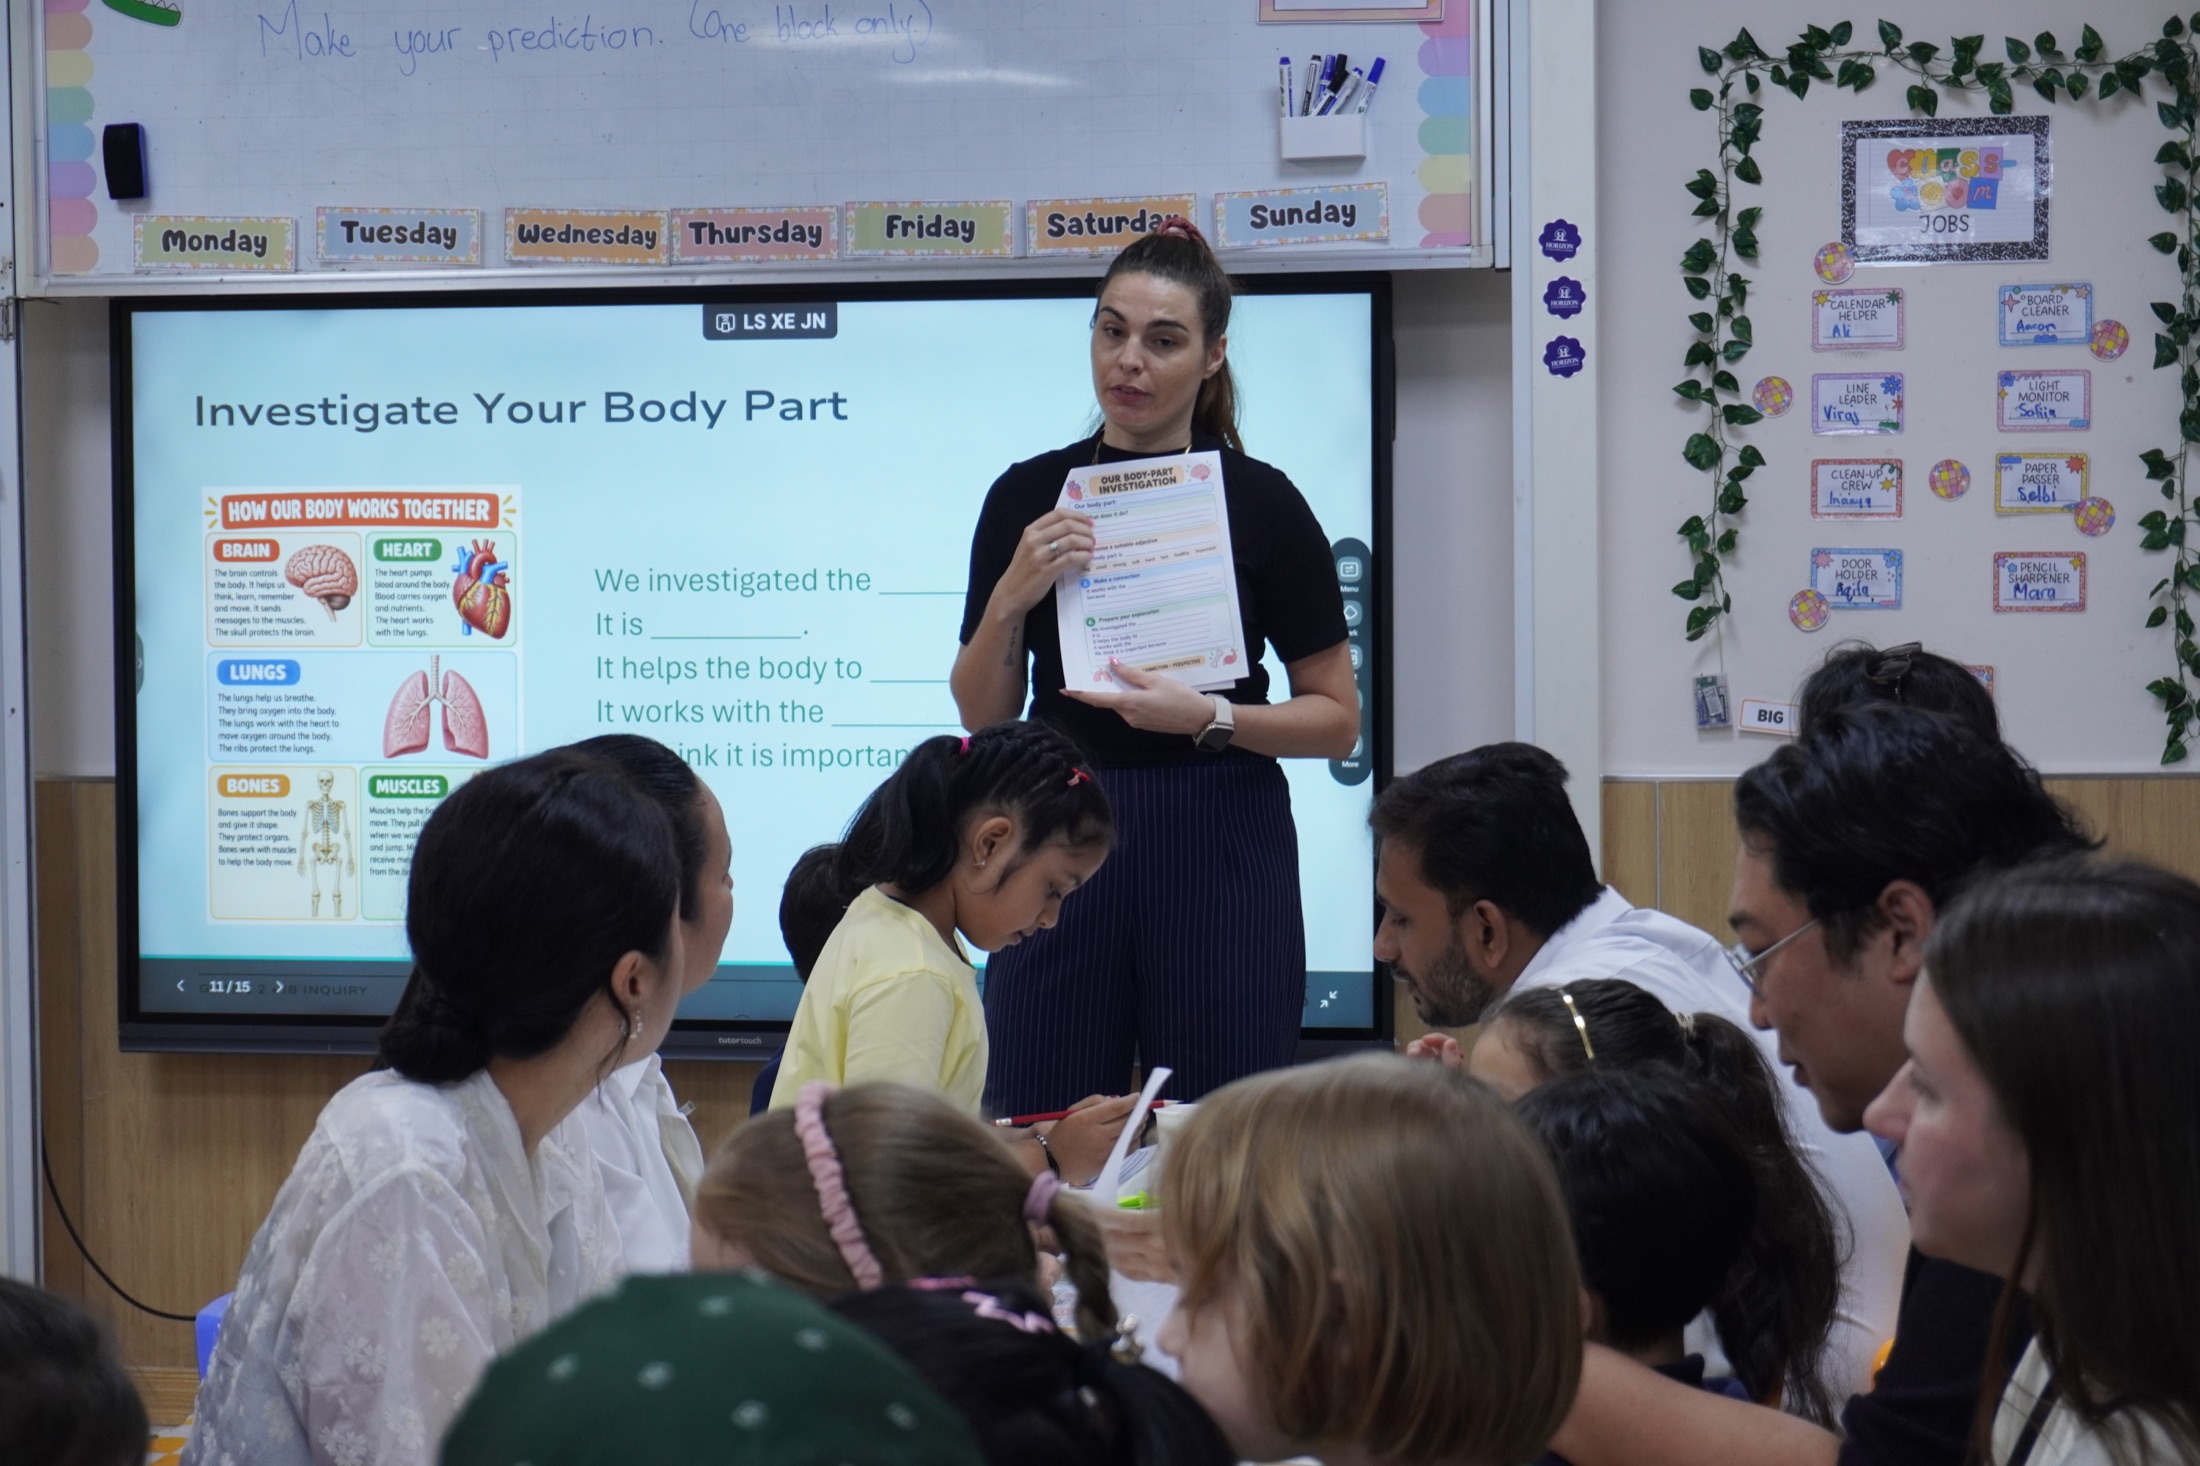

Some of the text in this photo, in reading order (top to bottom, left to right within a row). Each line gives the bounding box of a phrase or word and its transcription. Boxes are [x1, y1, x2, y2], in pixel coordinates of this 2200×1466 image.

[258, 0, 356, 60] Make
[394, 27, 461, 76] your
[487, 13, 664, 61] prediction.
[776, 3, 837, 43] block
[1249, 200, 1357, 230] Sunday
[885, 214, 976, 244] Friday
[1046, 209, 1179, 238] Saturda
[1919, 214, 1969, 233] JOBS
[340, 219, 459, 250] Tuesday
[516, 223, 659, 251] Wednesday
[688, 219, 824, 248] Thursday
[161, 227, 269, 258] Monday
[1830, 299, 1886, 310] CALENDAR
[2027, 294, 2063, 306] BOARD
[1839, 310, 1878, 321] HELPER
[2022, 305, 2069, 317] CLEANER
[744, 313, 826, 329] LS XE JN
[1551, 358, 1579, 367] HORIZON
[1846, 383, 1869, 394] LINE
[2029, 380, 2059, 391] LIGHT
[1839, 394, 1877, 405] LEADER
[2018, 392, 2069, 402] MONITOR
[195, 390, 848, 433] Investigate Your Body Part
[1831, 469, 1883, 479] CLEAN-UP
[2025, 463, 2057, 473] PAPER
[1102, 468, 1173, 484] OUR BODY-PART
[2022, 474, 2059, 485] PASSER
[1099, 476, 1176, 495] INVESTIGATION
[1842, 481, 1872, 491] CREW
[228, 498, 490, 522] HOW OUR BODY WORKS TOGETHER
[1103, 500, 1116, 508] part:
[222, 543, 270, 558] BRAIN
[383, 542, 432, 557] HEART
[1842, 559, 1872, 569] DOOR
[2021, 562, 2058, 572] PENCIL
[214, 569, 278, 577] The brain controls
[375, 569, 432, 578] The heart pumps
[1835, 570, 1878, 580] HOLDER
[2008, 572, 2070, 583] SHARPENER
[433, 581, 451, 590] body.
[595, 568, 871, 597] We investigated the
[422, 594, 447, 602] oxygen
[596, 612, 643, 636] It is
[407, 629, 428, 638] lungs.
[230, 664, 286, 680] LUNGS
[597, 655, 862, 684] It helps the body to
[218, 693, 231, 702] The
[233, 693, 253, 704] lungs
[255, 693, 270, 703] help
[285, 693, 316, 702] breathe.
[219, 706, 336, 716] They bring oxygen into the body.
[598, 699, 823, 723] It works with the
[1757, 709, 1783, 723] BIG
[219, 719, 232, 727] The
[234, 719, 254, 729] lungs
[257, 719, 275, 727] work
[278, 719, 294, 727] with
[296, 719, 307, 727] the
[310, 719, 329, 727] heart
[241, 733, 267, 741] oxygen
[269, 732, 295, 740] around
[298, 732, 310, 740] the
[312, 732, 332, 742] body.
[219, 744, 315, 754] The ribs protect the lungs.
[679, 742, 913, 772] ink it is importan
[1342, 760, 1359, 768] More
[227, 778, 280, 793] BONES
[376, 779, 440, 794] MUSCLES
[209, 980, 251, 993] 11/15
[304, 985, 368, 997] INQUIRY
[718, 1037, 761, 1045] tutortouch
